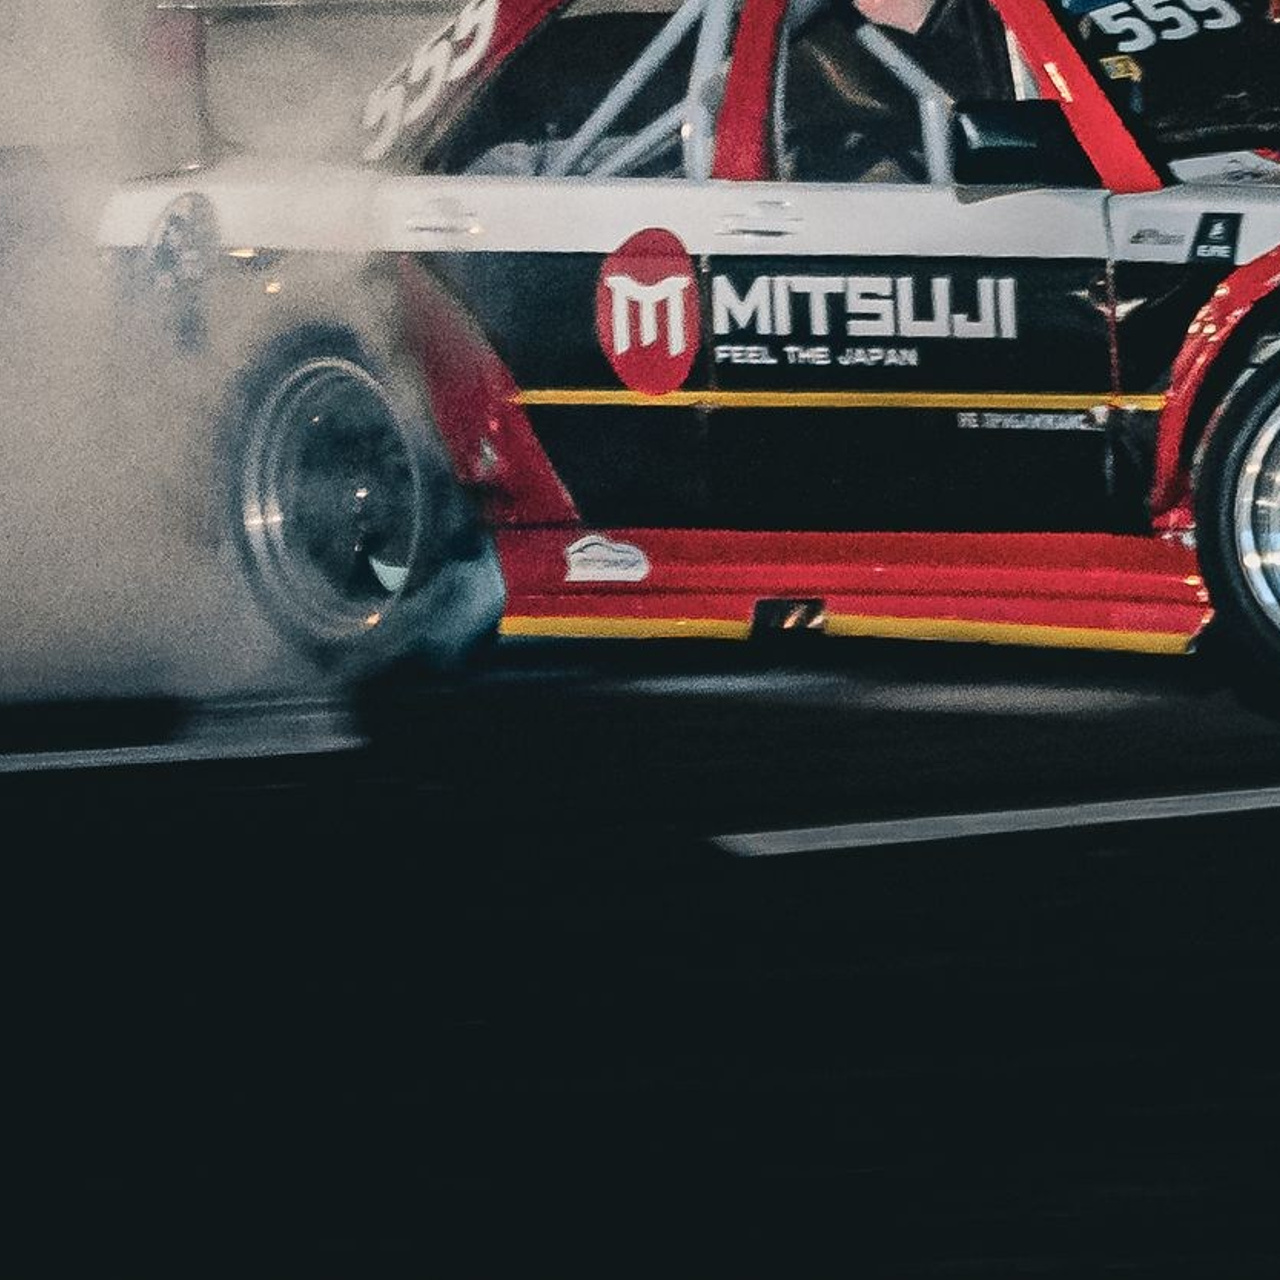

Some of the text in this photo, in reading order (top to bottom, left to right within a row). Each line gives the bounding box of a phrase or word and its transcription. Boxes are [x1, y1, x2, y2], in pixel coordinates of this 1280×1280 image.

[711, 274, 1018, 339] MITSUJI
[714, 345, 919, 367] FEEL THE JAPAN
